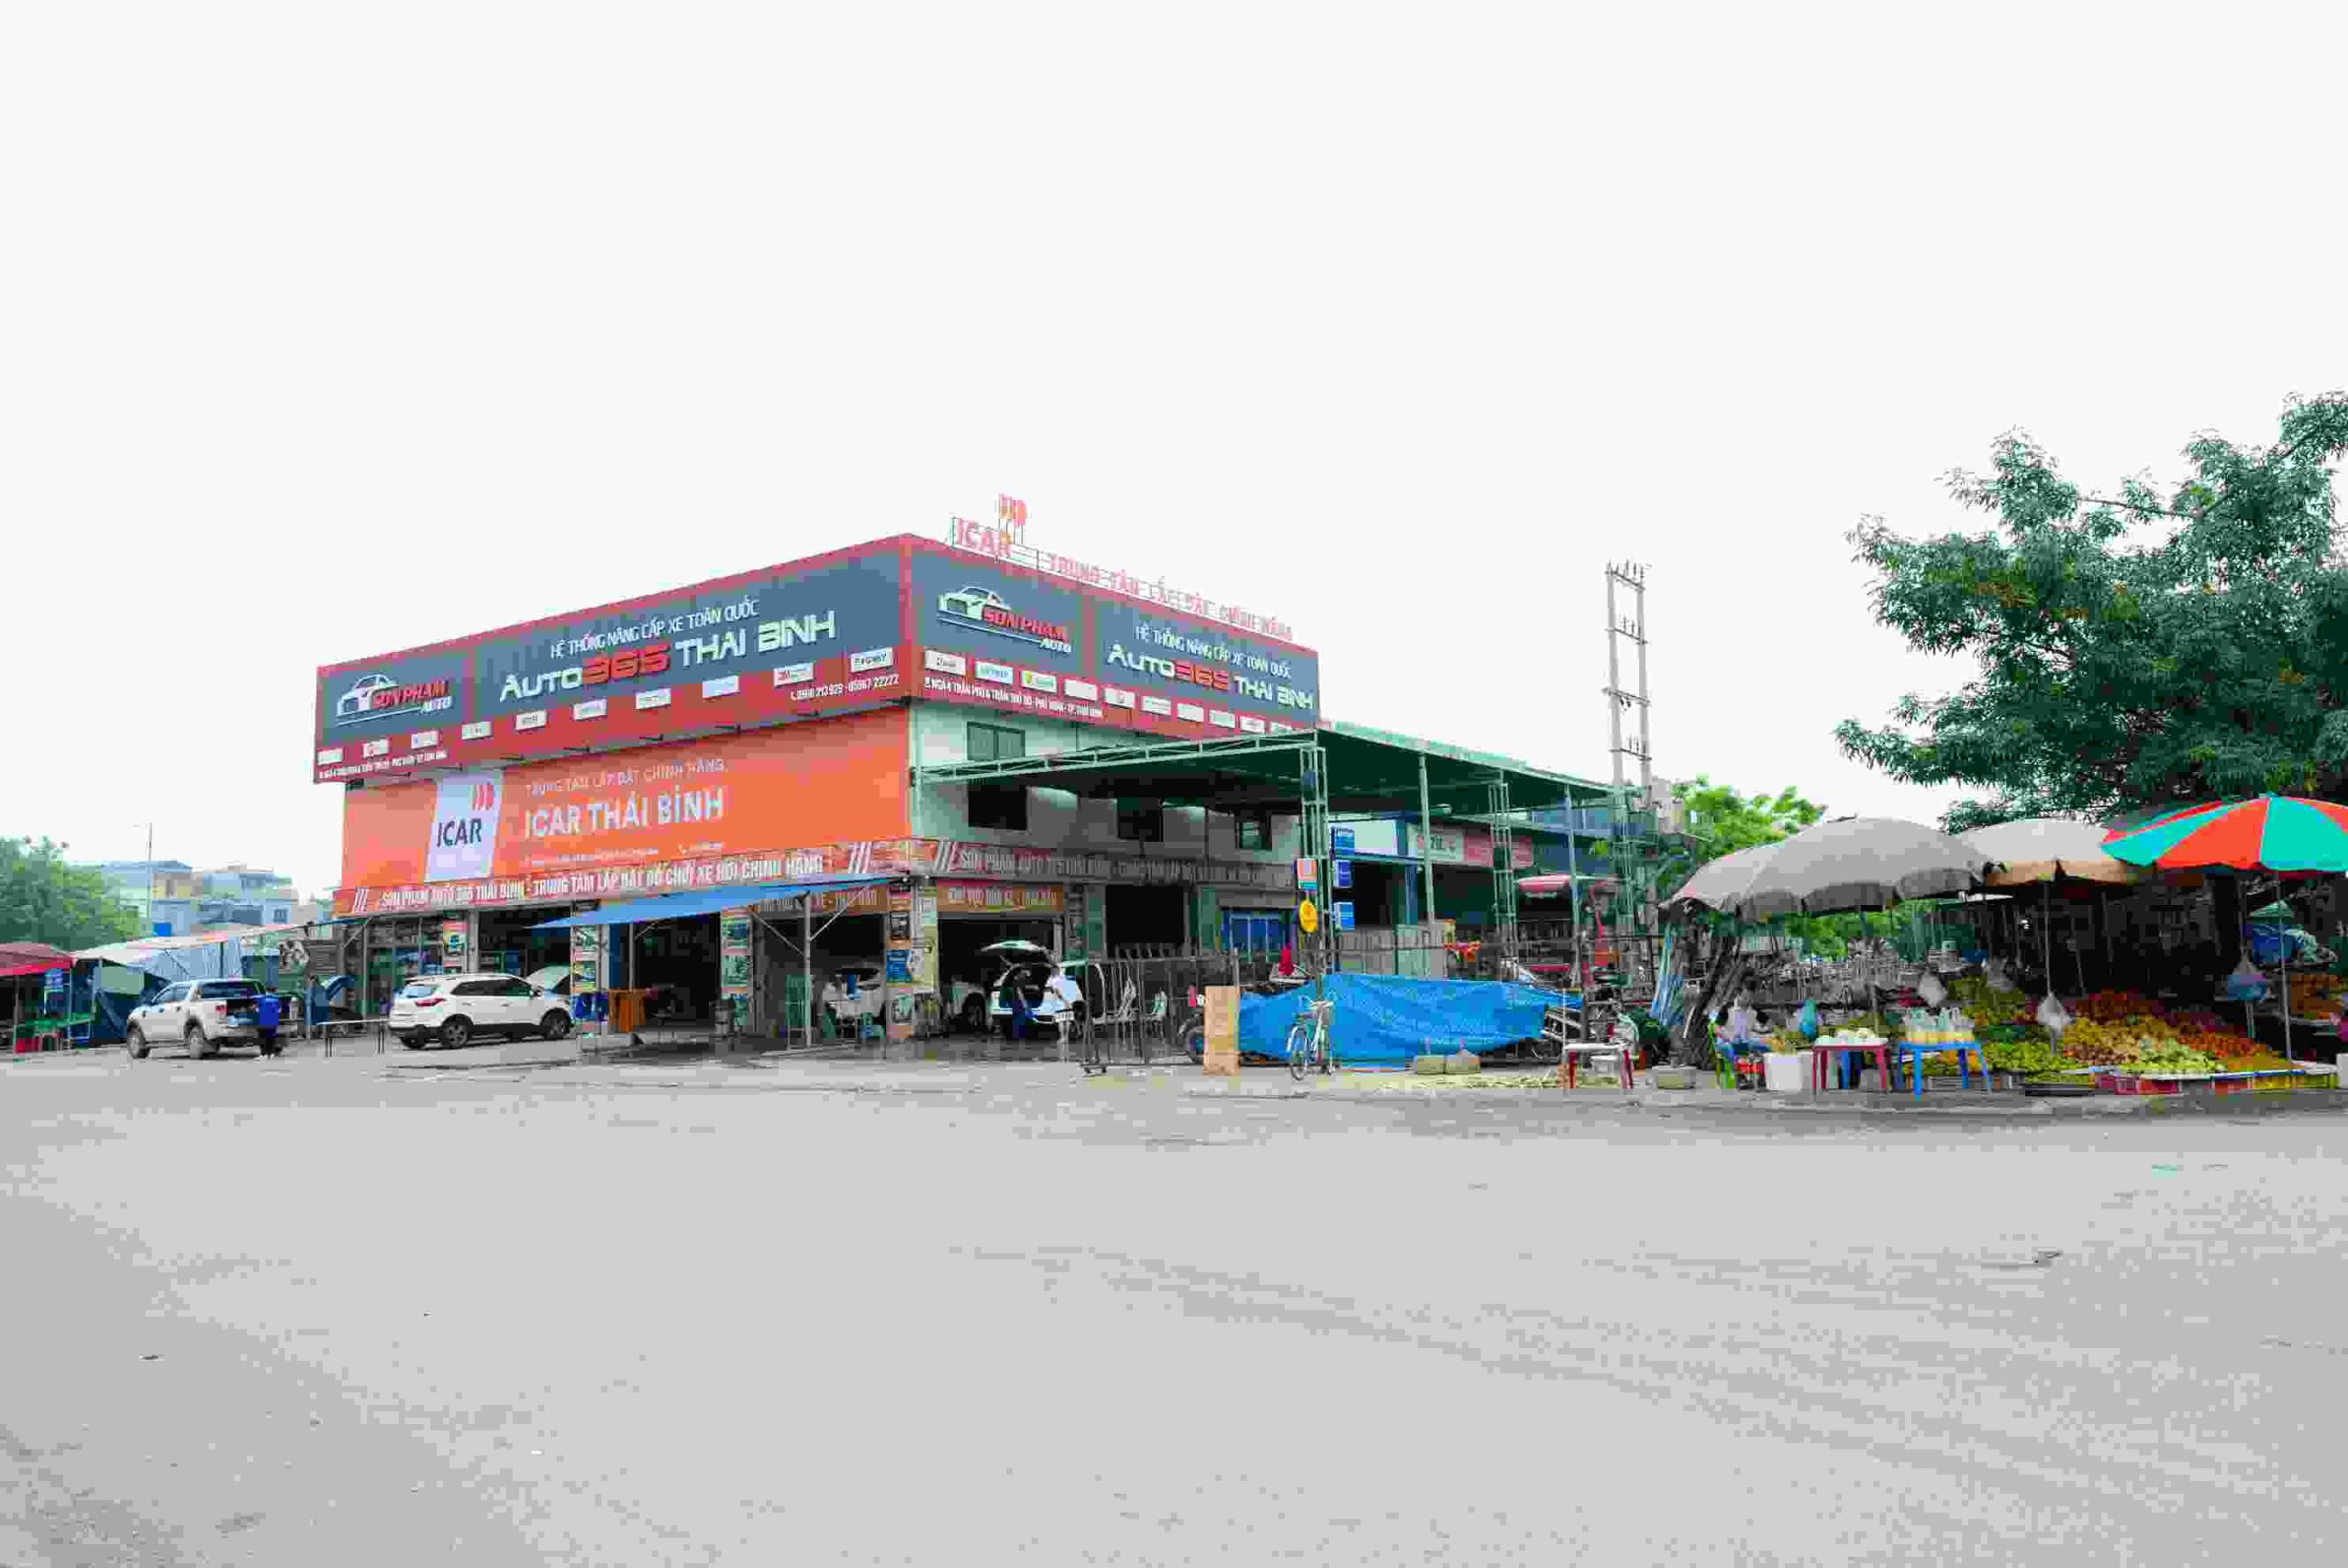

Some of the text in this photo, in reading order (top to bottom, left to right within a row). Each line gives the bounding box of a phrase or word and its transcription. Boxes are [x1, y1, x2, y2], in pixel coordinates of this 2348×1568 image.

[668, 615, 684, 633] XE
[587, 791, 648, 831] THÁI
[658, 784, 724, 823] BÌNH
